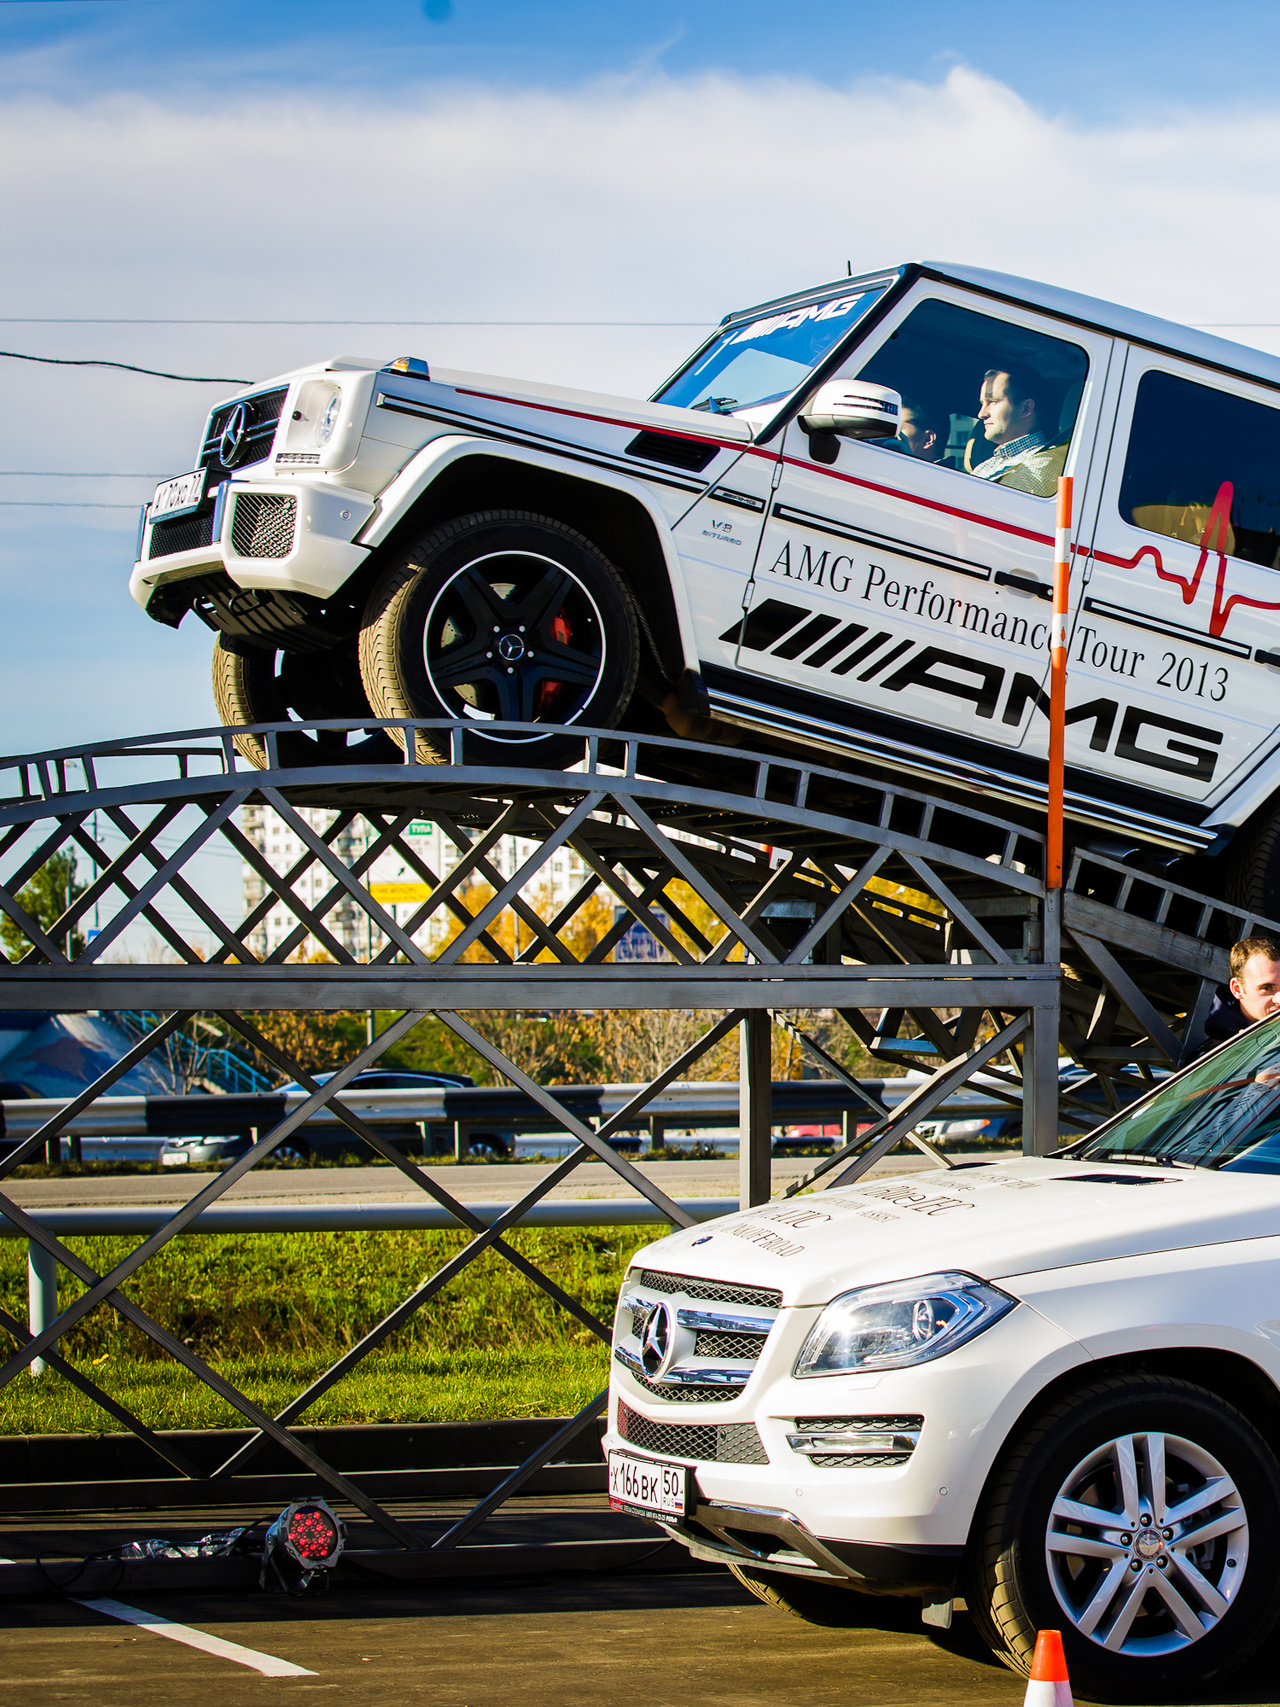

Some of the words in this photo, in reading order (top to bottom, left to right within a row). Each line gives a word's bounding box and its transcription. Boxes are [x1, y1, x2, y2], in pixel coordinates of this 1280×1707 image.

[711, 519, 733, 533] V8
[769, 540, 854, 593] AMG
[1077, 624, 1145, 680] Tour
[1156, 652, 1229, 702] 2013
[663, 1469, 679, 1497] 50
